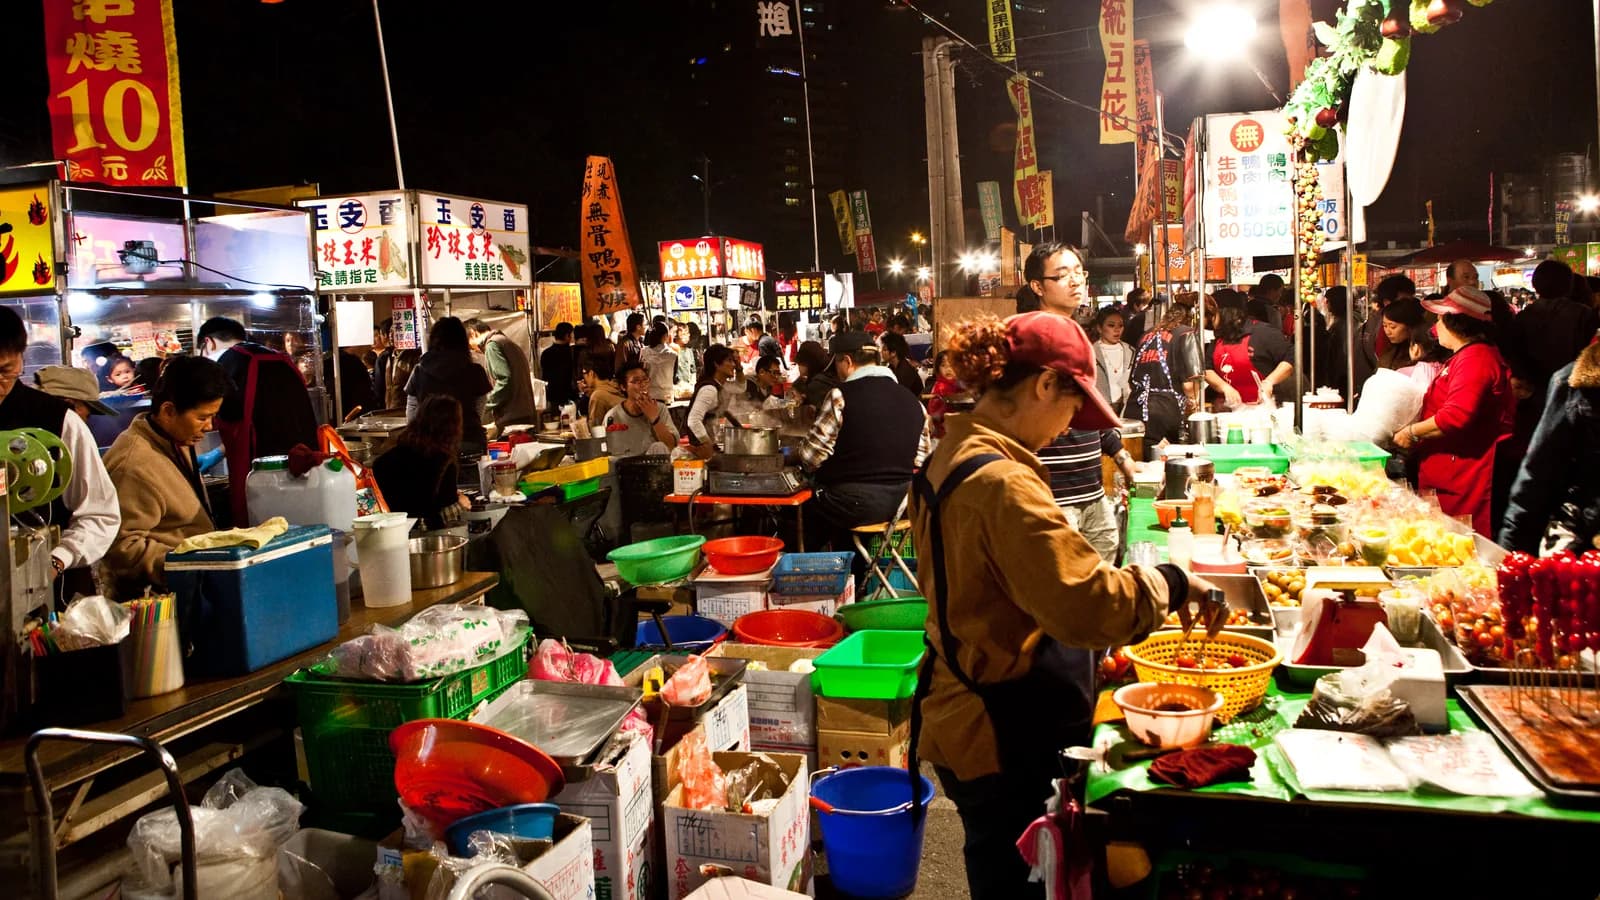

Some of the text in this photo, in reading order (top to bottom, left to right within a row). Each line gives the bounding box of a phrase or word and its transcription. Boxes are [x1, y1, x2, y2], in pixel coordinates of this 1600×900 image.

[1235, 124, 1260, 148] 無
[1219, 222, 1239, 238] 80
[317, 238, 377, 268] 珠玉米
[427, 226, 495, 263] 珍珠玉米
